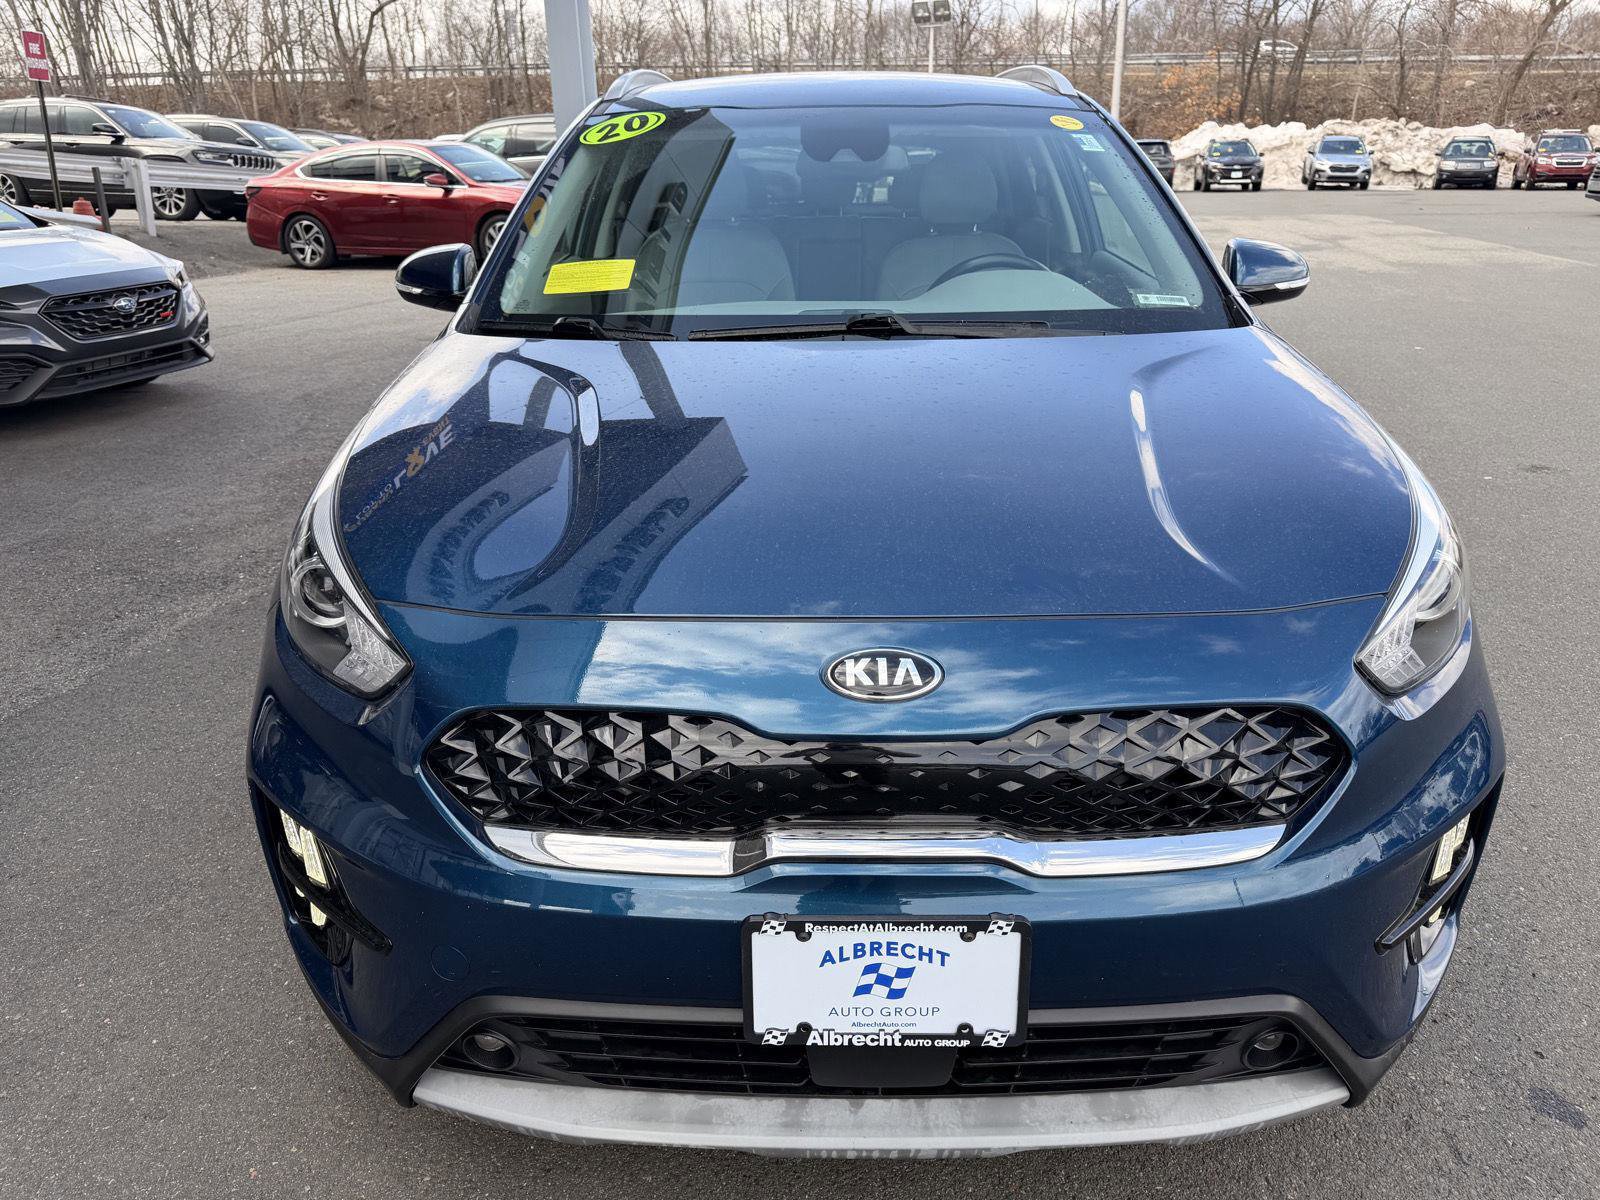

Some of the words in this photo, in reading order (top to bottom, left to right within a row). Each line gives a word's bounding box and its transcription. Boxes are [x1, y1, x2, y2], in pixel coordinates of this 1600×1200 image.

[595, 115, 649, 142] 20
[844, 657, 923, 687] KIA
[804, 922, 968, 934] RespectAtAlbrecht.com
[819, 941, 950, 969] ALBRECHT
[828, 1006, 874, 1017] AUTO
[880, 1006, 940, 1017] GROUP
[806, 1029, 902, 1047] Albrecht
[904, 1039, 932, 1047] AUTO
[934, 1039, 971, 1047] GROUP
